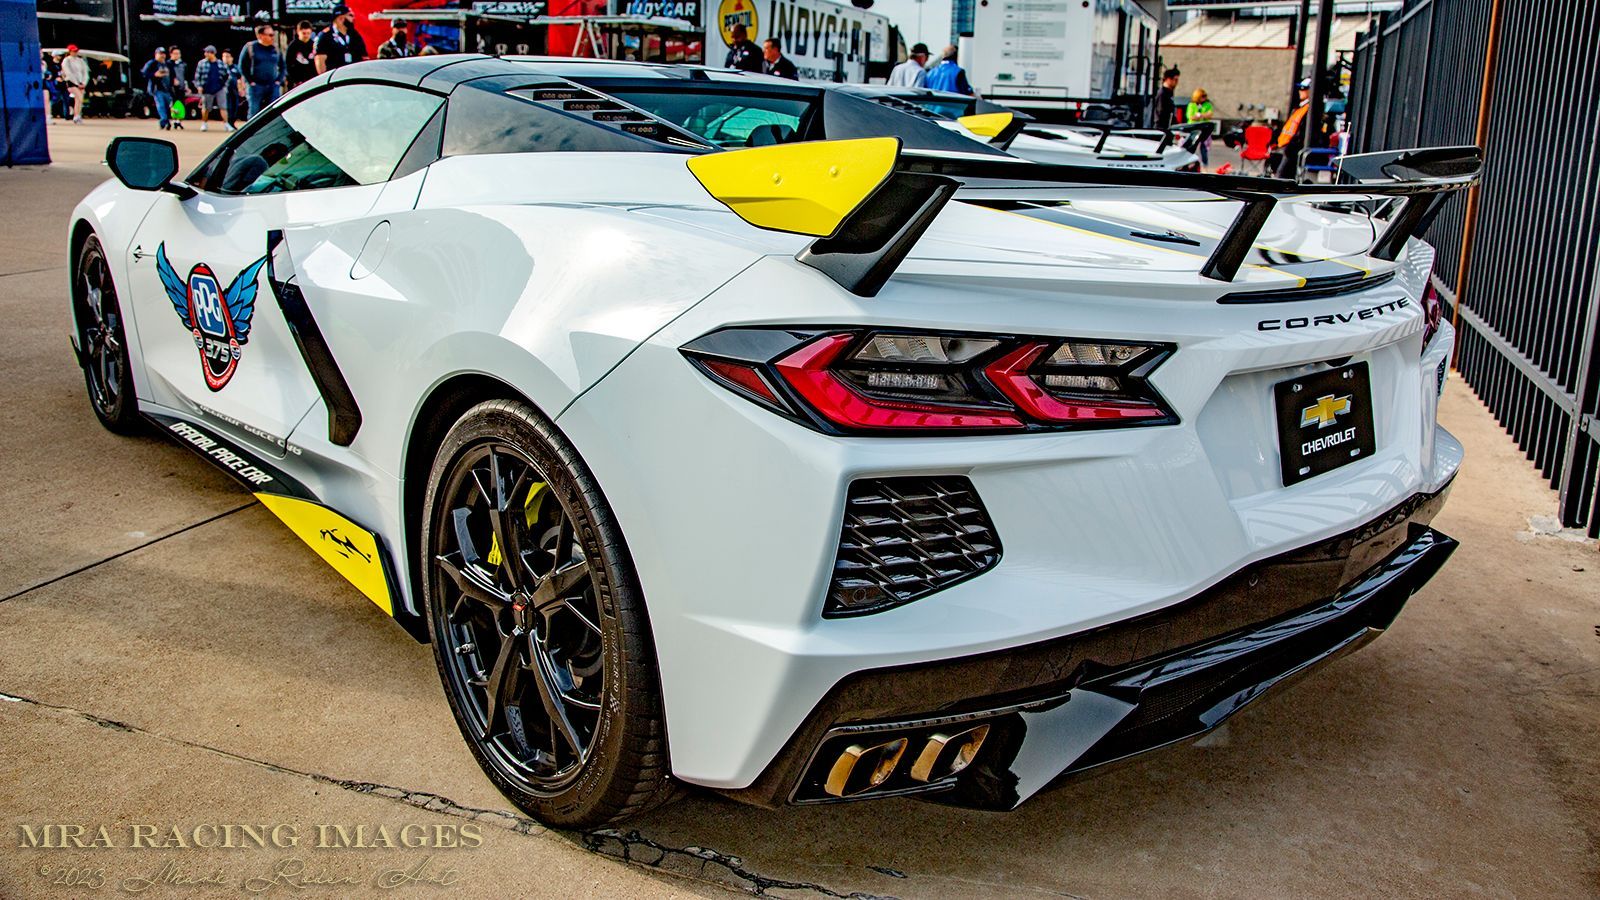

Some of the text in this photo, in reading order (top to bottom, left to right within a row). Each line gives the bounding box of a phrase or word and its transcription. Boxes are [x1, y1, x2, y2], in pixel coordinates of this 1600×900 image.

[625, 2, 697, 17] INDYCAR
[193, 281, 222, 327] PPG
[1258, 297, 1410, 331] CORVETTE
[205, 338, 230, 363] 375
[169, 421, 273, 485] OFFICIAL PACE CAR
[1302, 427, 1356, 456] CHEVROLET
[570, 501, 614, 612] MICHELIN
